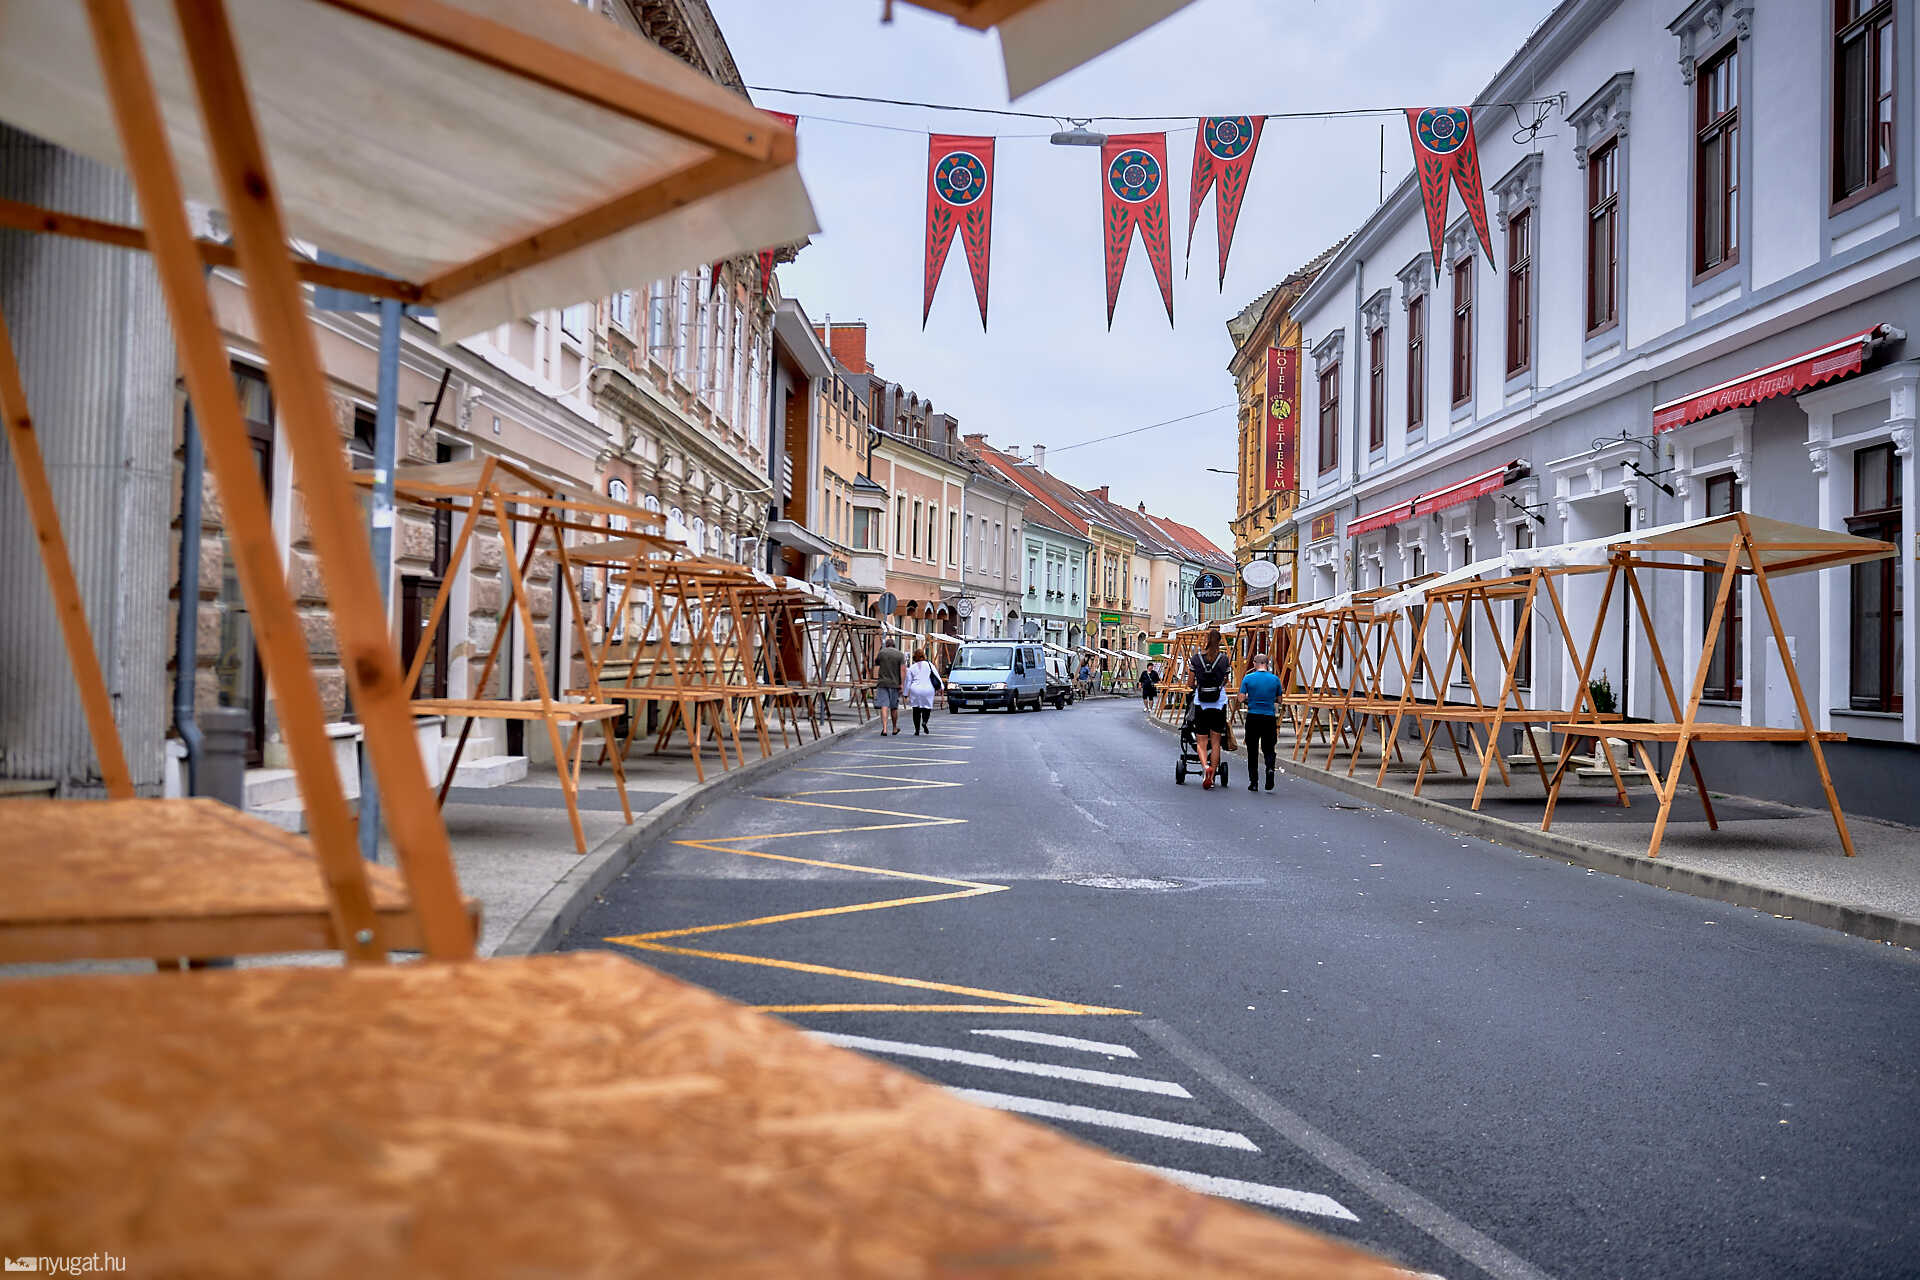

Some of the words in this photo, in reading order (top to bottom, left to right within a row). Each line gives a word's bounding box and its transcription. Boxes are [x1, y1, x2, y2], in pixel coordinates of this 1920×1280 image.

[1276, 350, 1287, 393] HOTEL
[1720, 388, 1748, 405] HOTEL
[1749, 383, 1757, 398] &
[1274, 421, 1287, 488] ÉTTEREM
